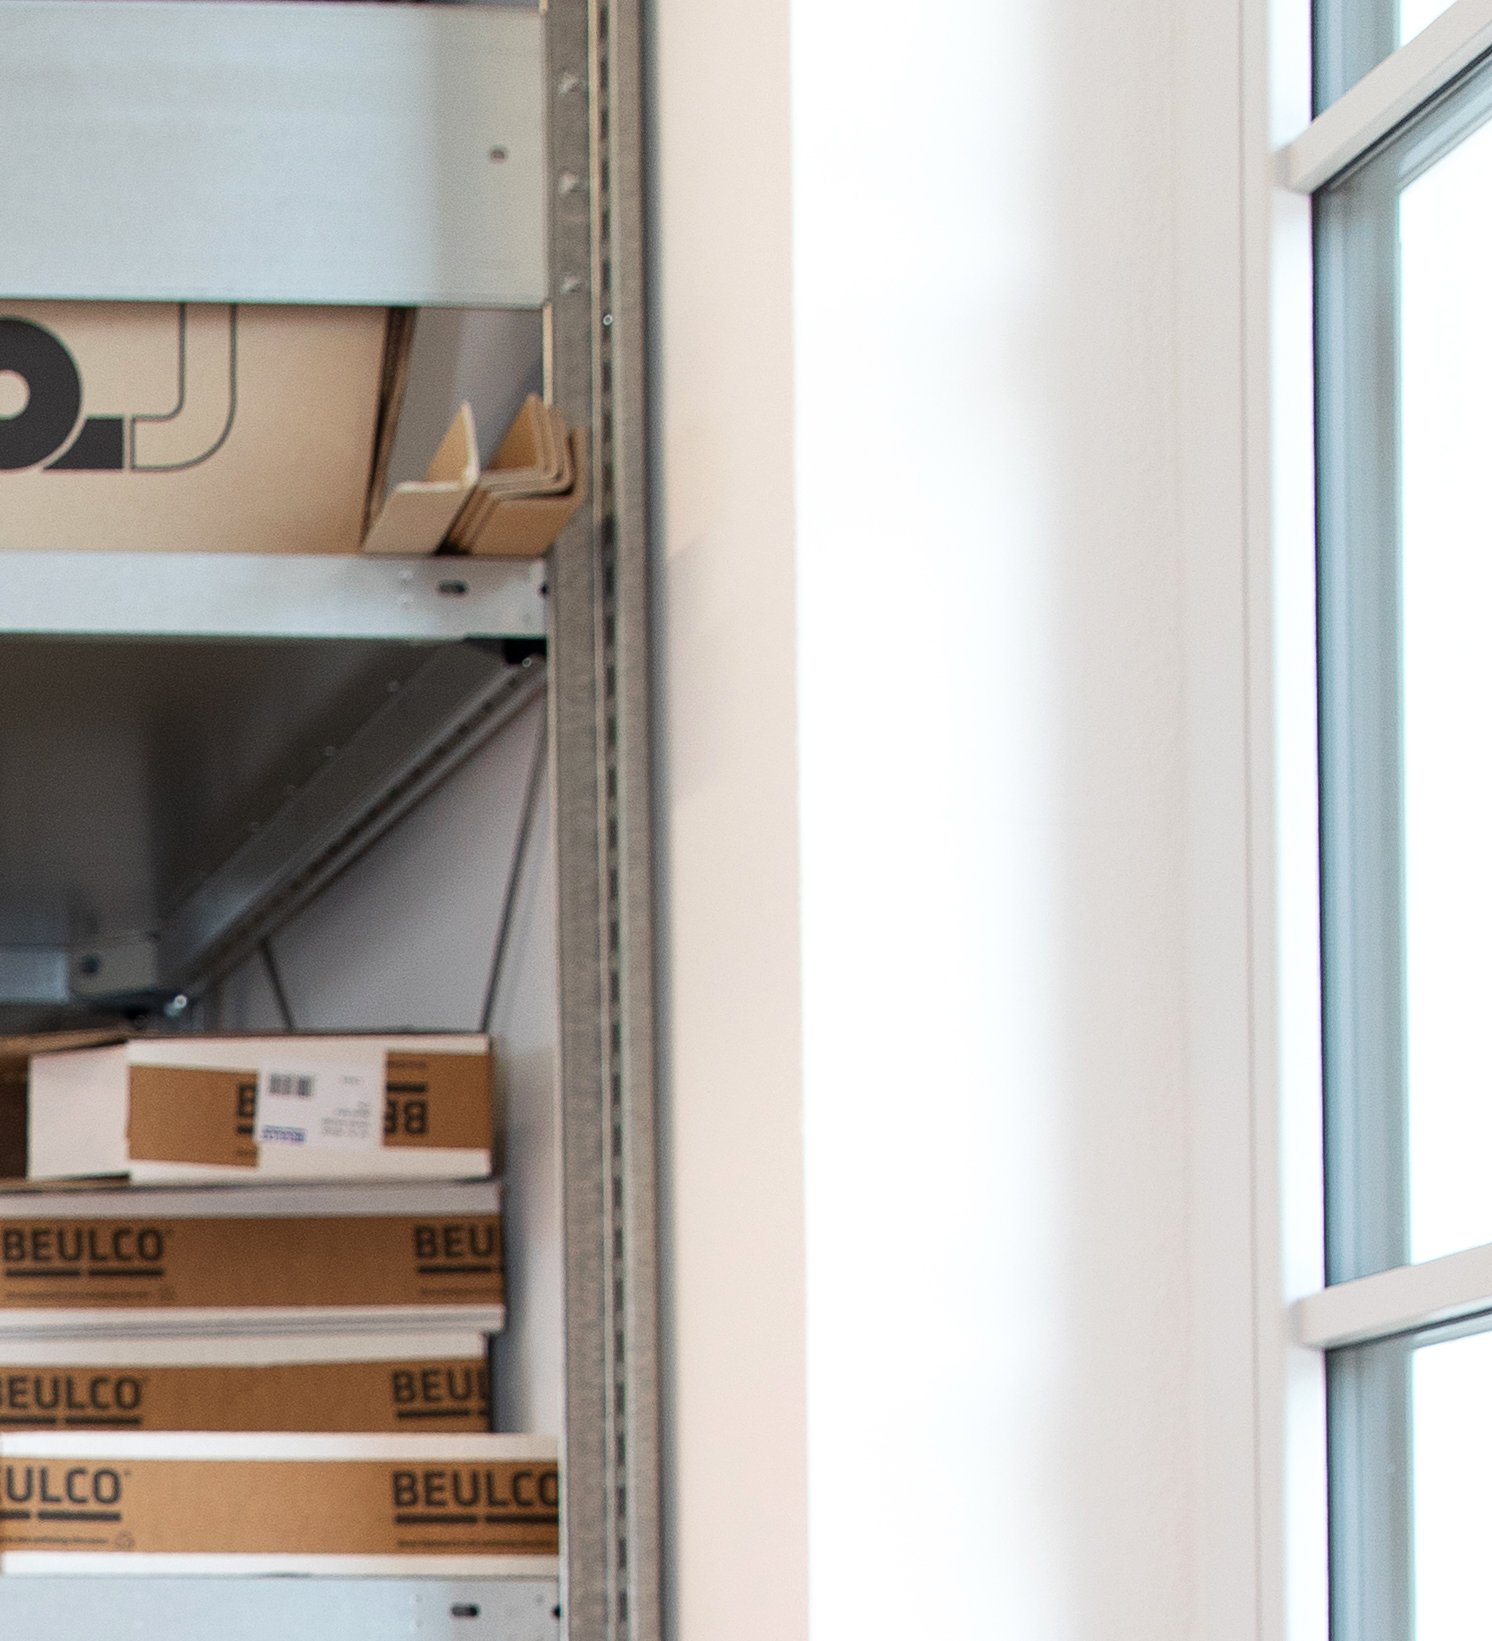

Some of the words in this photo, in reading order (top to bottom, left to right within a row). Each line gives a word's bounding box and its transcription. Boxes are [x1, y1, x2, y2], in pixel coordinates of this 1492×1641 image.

[3, 1227, 164, 1262] BEULCO
[415, 1225, 494, 1258] BEU
[393, 1470, 558, 1507] BEULCO
